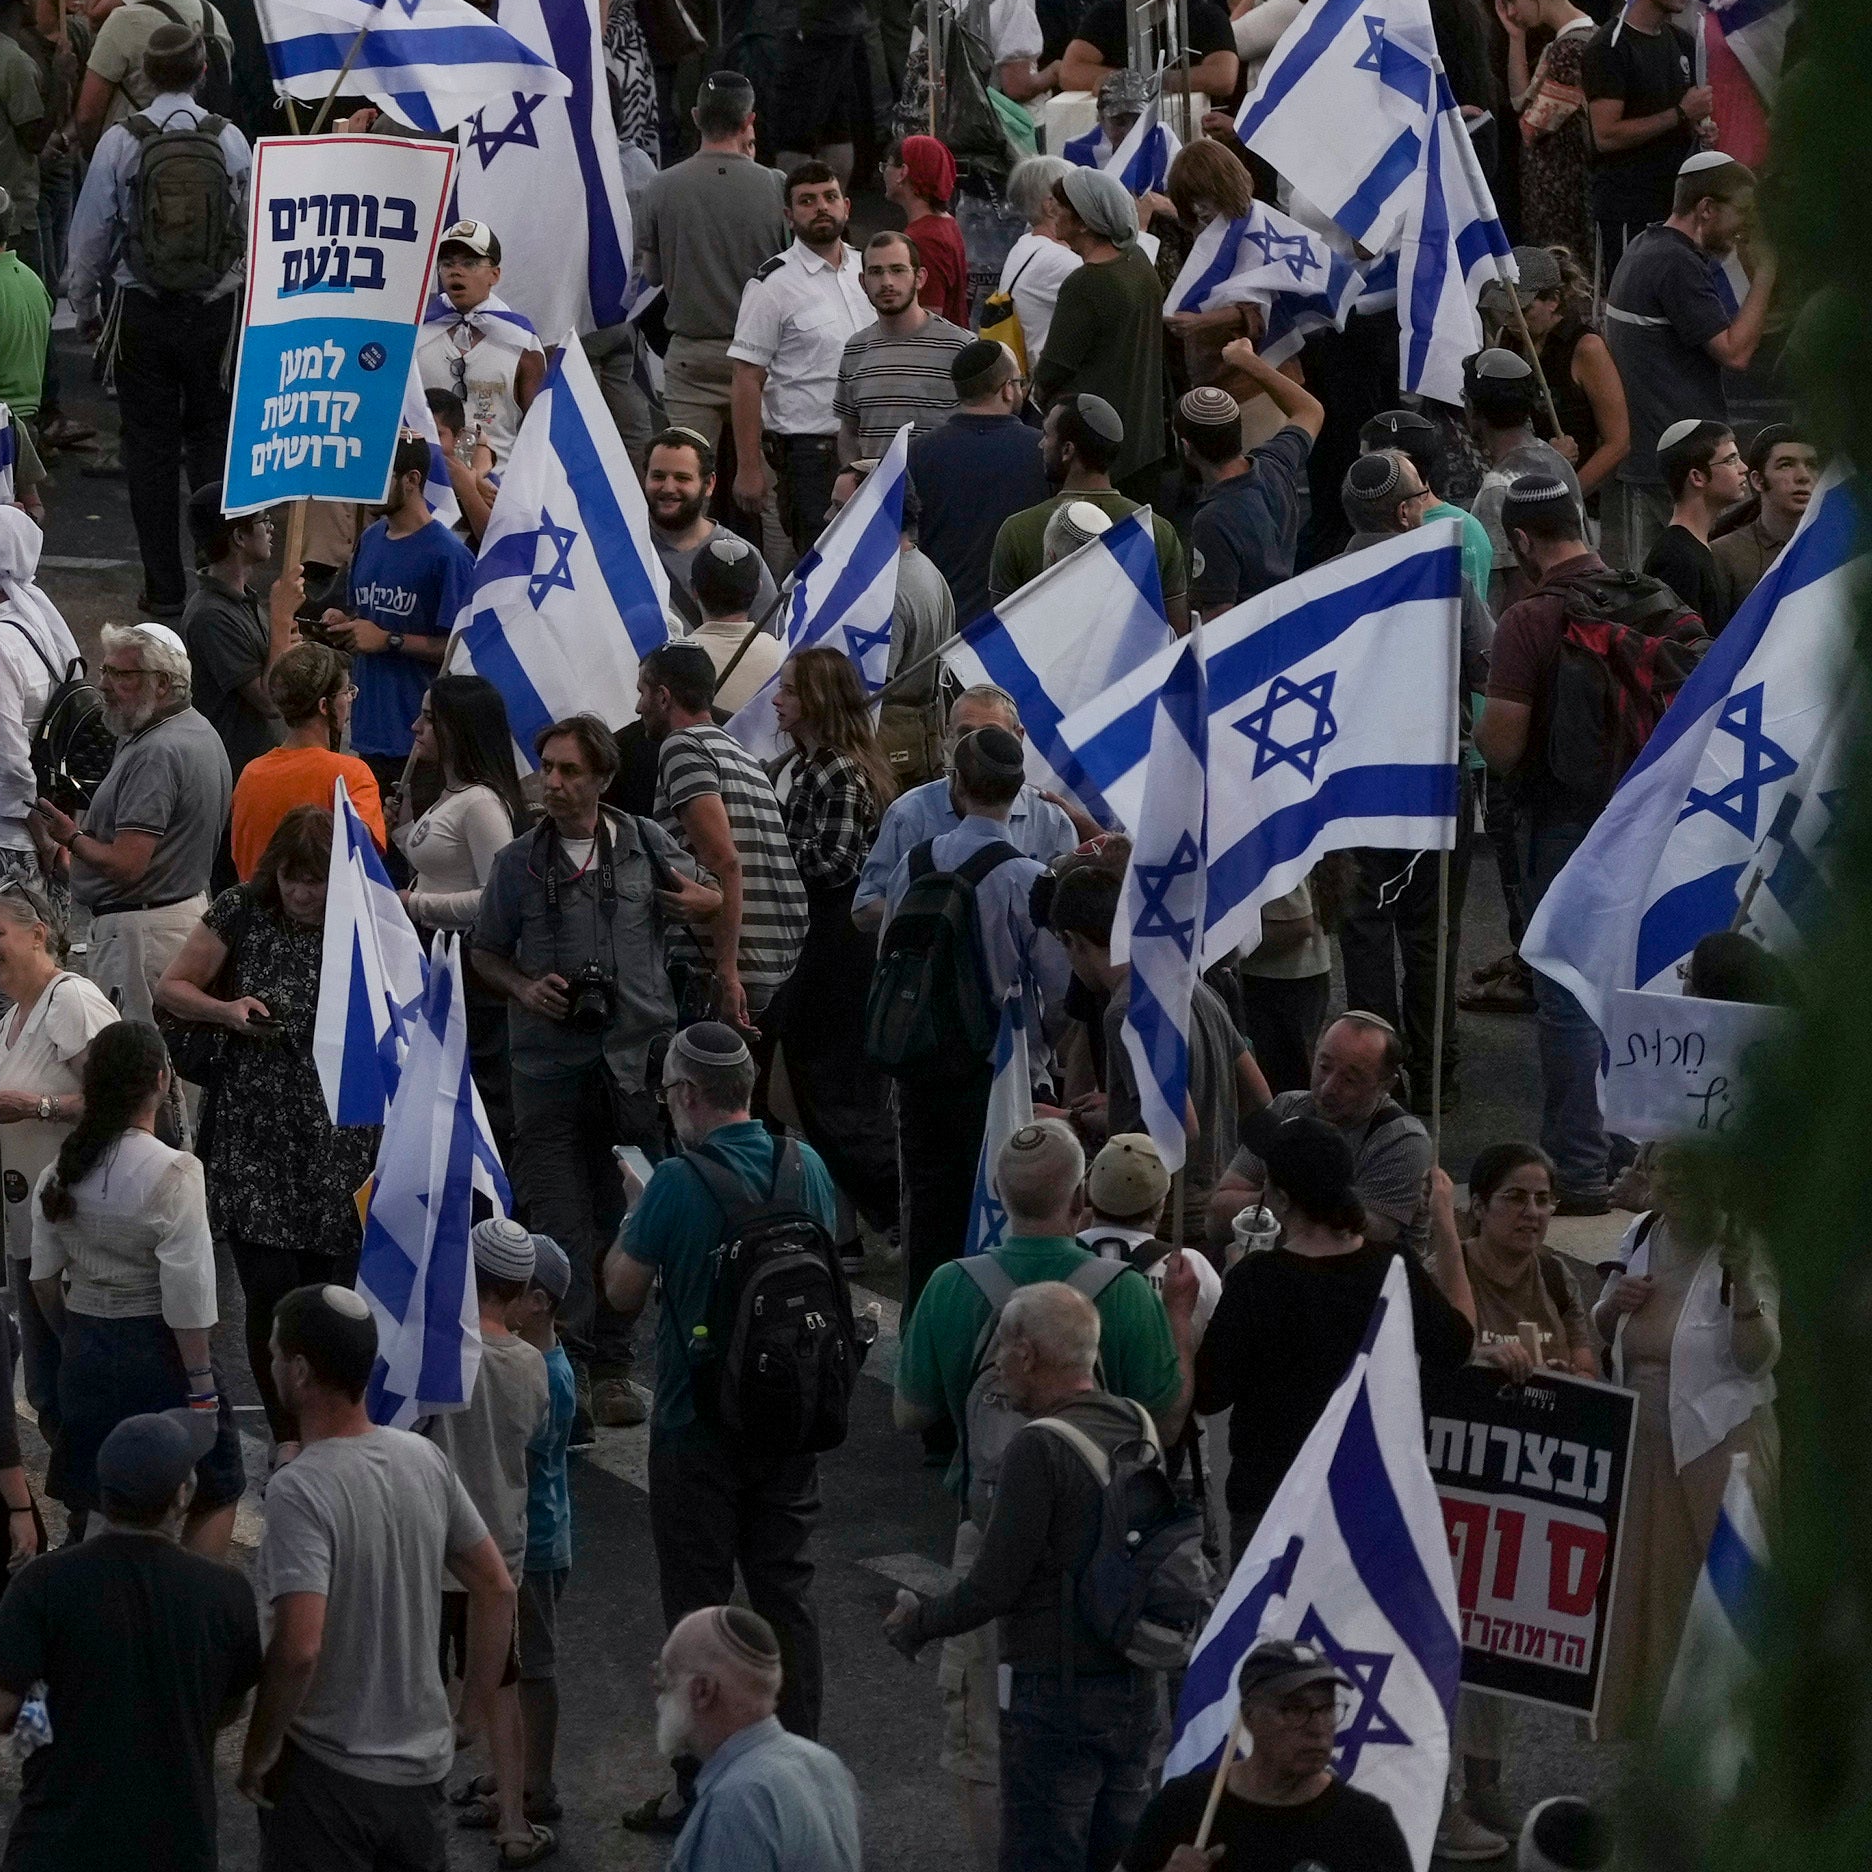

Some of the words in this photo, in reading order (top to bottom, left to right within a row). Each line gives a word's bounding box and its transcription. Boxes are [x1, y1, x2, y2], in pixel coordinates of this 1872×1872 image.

[268, 193, 419, 243] בוחרים
[279, 338, 346, 393] למען
[261, 390, 361, 434] קדושת
[250, 432, 362, 478] ירושלים
[1428, 1415, 1613, 1505] נבצרות
[1461, 1608, 1587, 1668] הדמוקר
